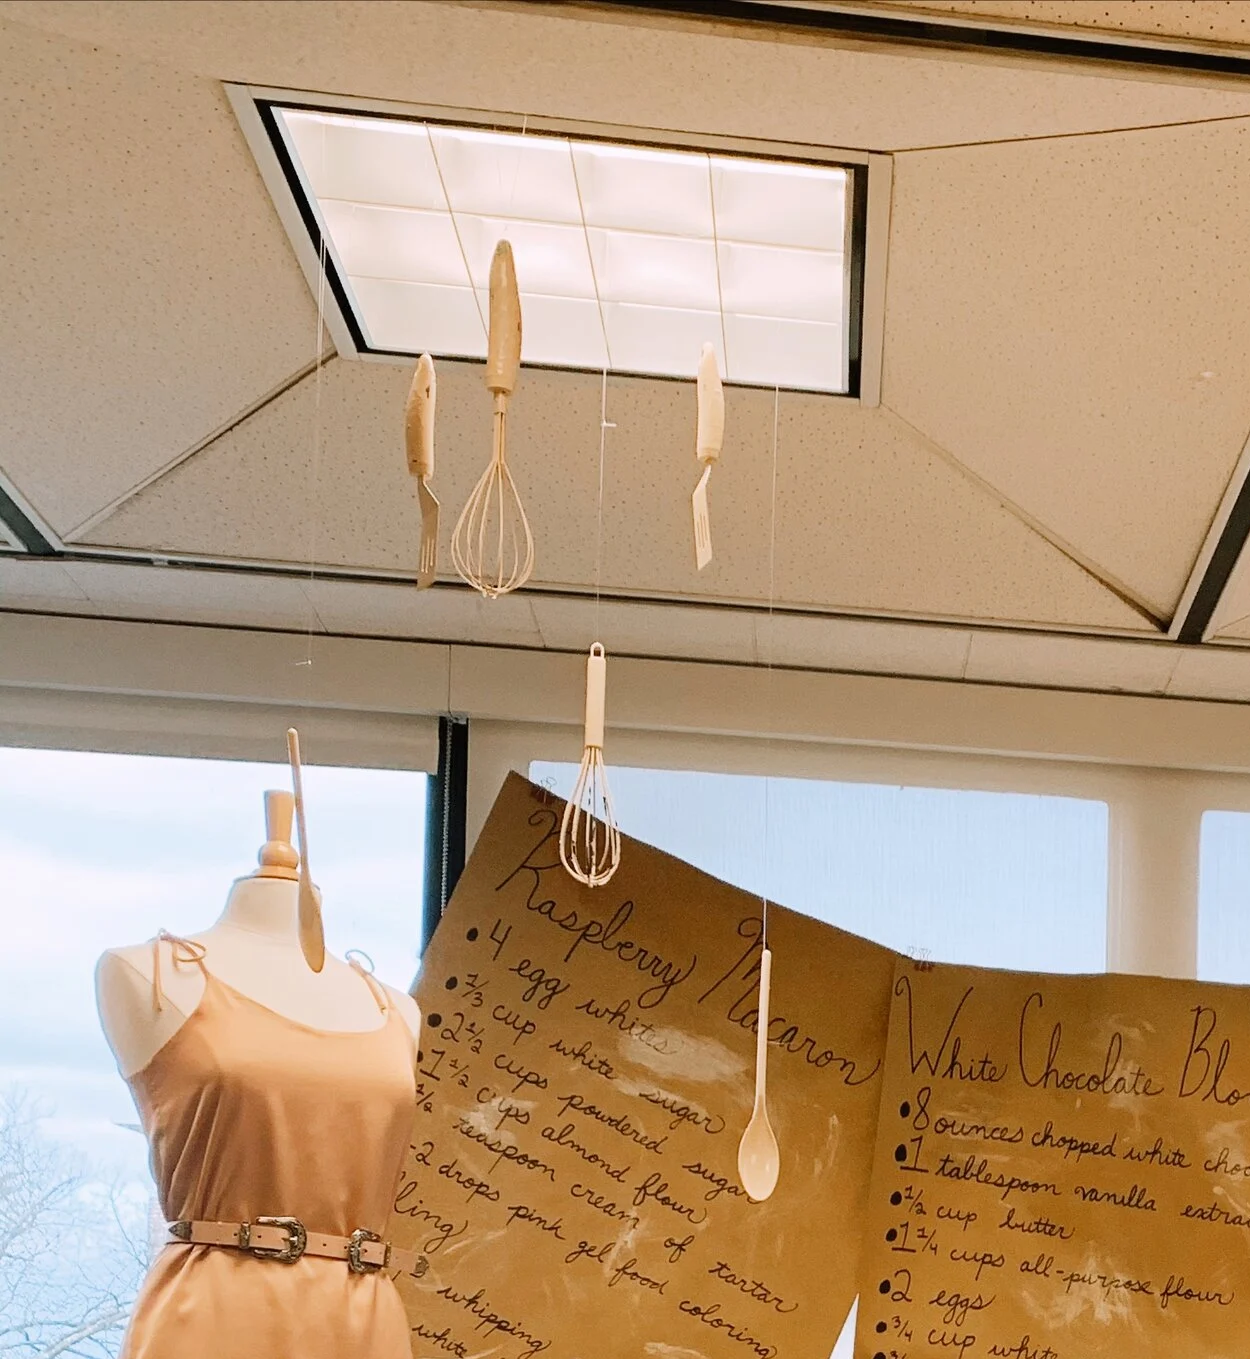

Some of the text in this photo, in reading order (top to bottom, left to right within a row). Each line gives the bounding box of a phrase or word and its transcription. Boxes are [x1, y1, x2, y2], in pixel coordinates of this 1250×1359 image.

[489, 918, 511, 962] 4
[509, 958, 570, 1010] egg
[492, 1003, 537, 1040] cup
[549, 1039, 619, 1081] white
[639, 1087, 727, 1135] sugar
[894, 976, 1007, 1082] White
[1019, 993, 1164, 1098] Chocolate
[494, 1053, 548, 1096] cups
[557, 1093, 663, 1155] powdered
[911, 1087, 931, 1131] 8
[933, 1118, 1024, 1143] ounces
[1031, 1121, 1118, 1161] chopped
[1122, 1137, 1191, 1169] white
[452, 1105, 557, 1182] teaspoon
[570, 1184, 640, 1229] cream
[663, 1235, 695, 1263] of
[708, 1261, 799, 1313] tartar
[541, 1126, 626, 1184] almond
[633, 1180, 707, 1225] flour
[900, 1137, 929, 1173] 1
[935, 1154, 1062, 1200] tablespoon
[1075, 1183, 1158, 1213] vanilla
[438, 1159, 500, 1203] drops
[507, 1204, 568, 1241] pink
[565, 1240, 606, 1264] gel
[609, 1263, 670, 1295] food
[936, 1205, 978, 1229] cup
[999, 1211, 1075, 1241] butter
[436, 1286, 552, 1357] whipping
[890, 1268, 997, 1326] 2 eggs
[949, 1248, 1005, 1281] cups
[1159, 1276, 1235, 1309] flour
[411, 1324, 470, 1359] white
